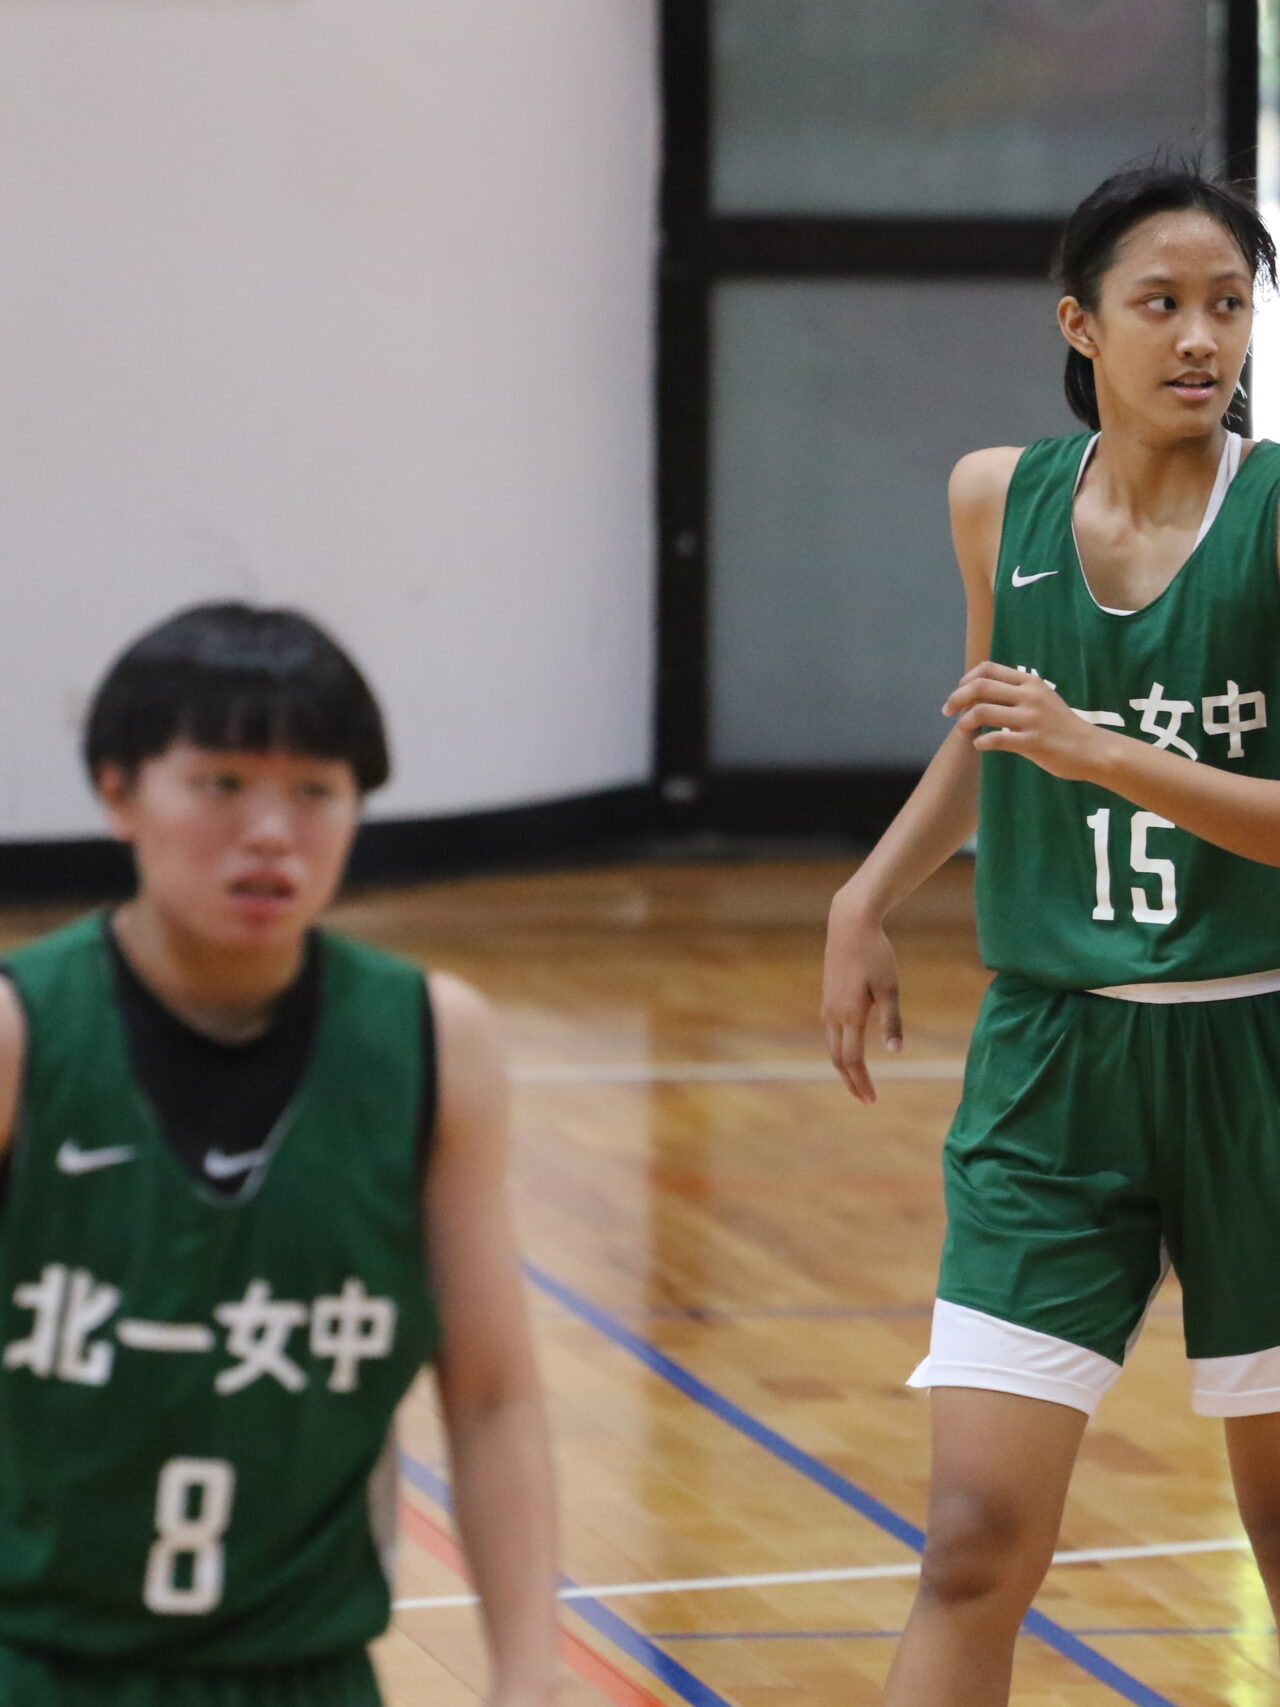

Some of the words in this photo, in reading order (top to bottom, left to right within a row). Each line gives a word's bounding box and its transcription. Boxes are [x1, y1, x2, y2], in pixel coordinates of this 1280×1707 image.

[1001, 665, 1267, 760] 一女中
[1086, 807, 1178, 925] 15
[3, 1263, 399, 1393] 北一女中
[143, 1457, 236, 1615] 8
